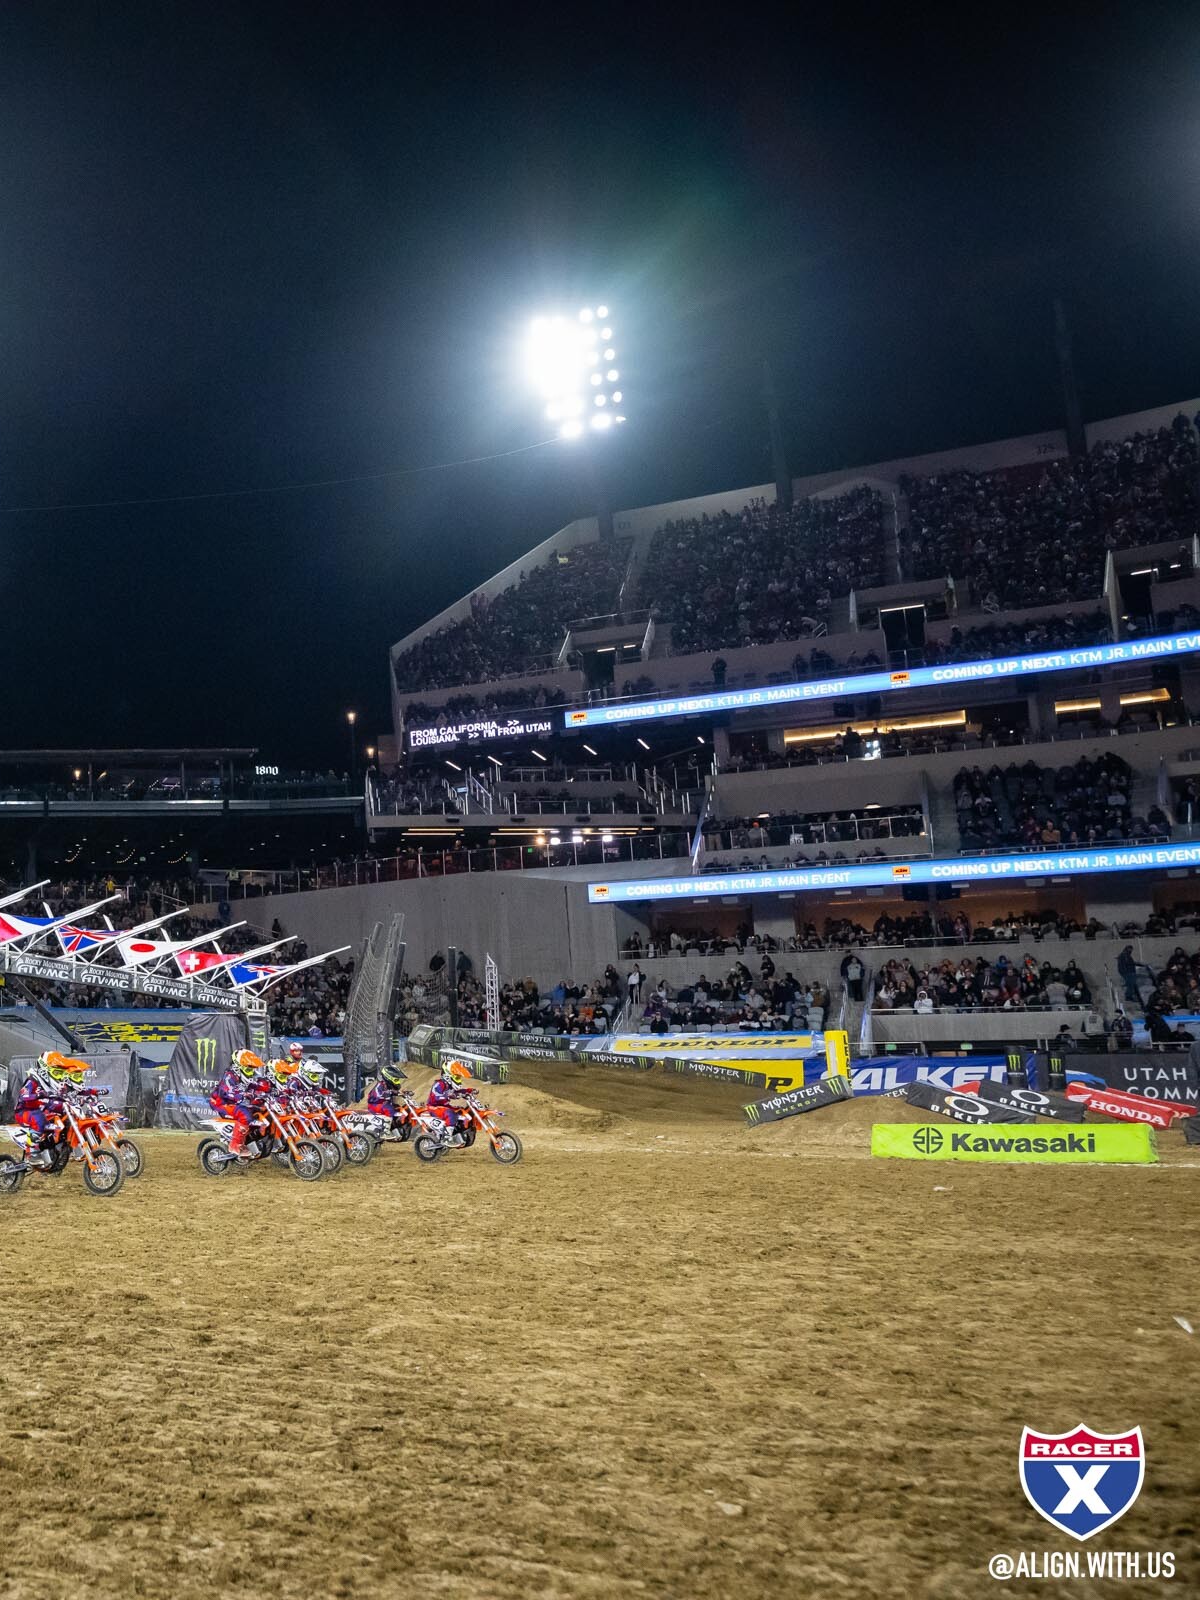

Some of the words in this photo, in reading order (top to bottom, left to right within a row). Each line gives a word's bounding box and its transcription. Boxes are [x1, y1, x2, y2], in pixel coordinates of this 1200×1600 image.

[932, 664, 993, 681] COMING
[999, 661, 1018, 673] UP
[1022, 655, 1066, 670] NEXT:
[1070, 651, 1103, 665] KTM
[1106, 646, 1128, 660] JR.
[1132, 640, 1172, 656] MAIN
[606, 703, 655, 720] COMING
[658, 702, 675, 714] UP
[678, 698, 714, 712] NEXT:
[717, 695, 744, 707] KTM
[748, 692, 764, 703] JR.
[767, 687, 800, 701] MAIN
[803, 682, 846, 696] EVENT
[410, 728, 438, 739] FROM
[411, 733, 460, 747] LOUISIANA.
[483, 728, 496, 738] I'M
[498, 725, 524, 736] FROM
[526, 722, 551, 733] UTAH
[932, 863, 988, 877] COMING
[992, 862, 1011, 873] UP
[1014, 859, 1054, 872] NEXT:
[1058, 856, 1088, 869] KTM
[1092, 855, 1112, 867] JR.
[1115, 852, 1152, 866] MAIN
[626, 884, 672, 897] COMING
[676, 883, 692, 893] UP
[694, 880, 729, 892] NEXT:
[731, 878, 756, 889] KTM
[759, 877, 775, 888] JR.
[778, 874, 809, 887] MAIN
[811, 872, 850, 885] EVENT
[42, 960, 69, 971] MOUNTAIN
[105, 970, 129, 980] MOUNTAIN
[519, 1034, 552, 1044] MONSTER
[655, 1038, 797, 1047] DUNLOP
[519, 1048, 555, 1058] MONSTER
[591, 1053, 636, 1065] MONSTER
[688, 1062, 740, 1078] MONSTER
[1123, 1067, 1187, 1081] UTAH
[761, 1085, 825, 1111] MONSTER
[97, 1105, 106, 1114] 8
[180, 1107, 219, 1116] CHAMPIONS
[775, 1098, 817, 1115] ENERGY
[930, 1104, 993, 1125] OAKLE
[999, 1097, 1057, 1116] OAKLEY
[1090, 1100, 1167, 1127] HONDA
[951, 1133, 1095, 1153] Kawasaki
